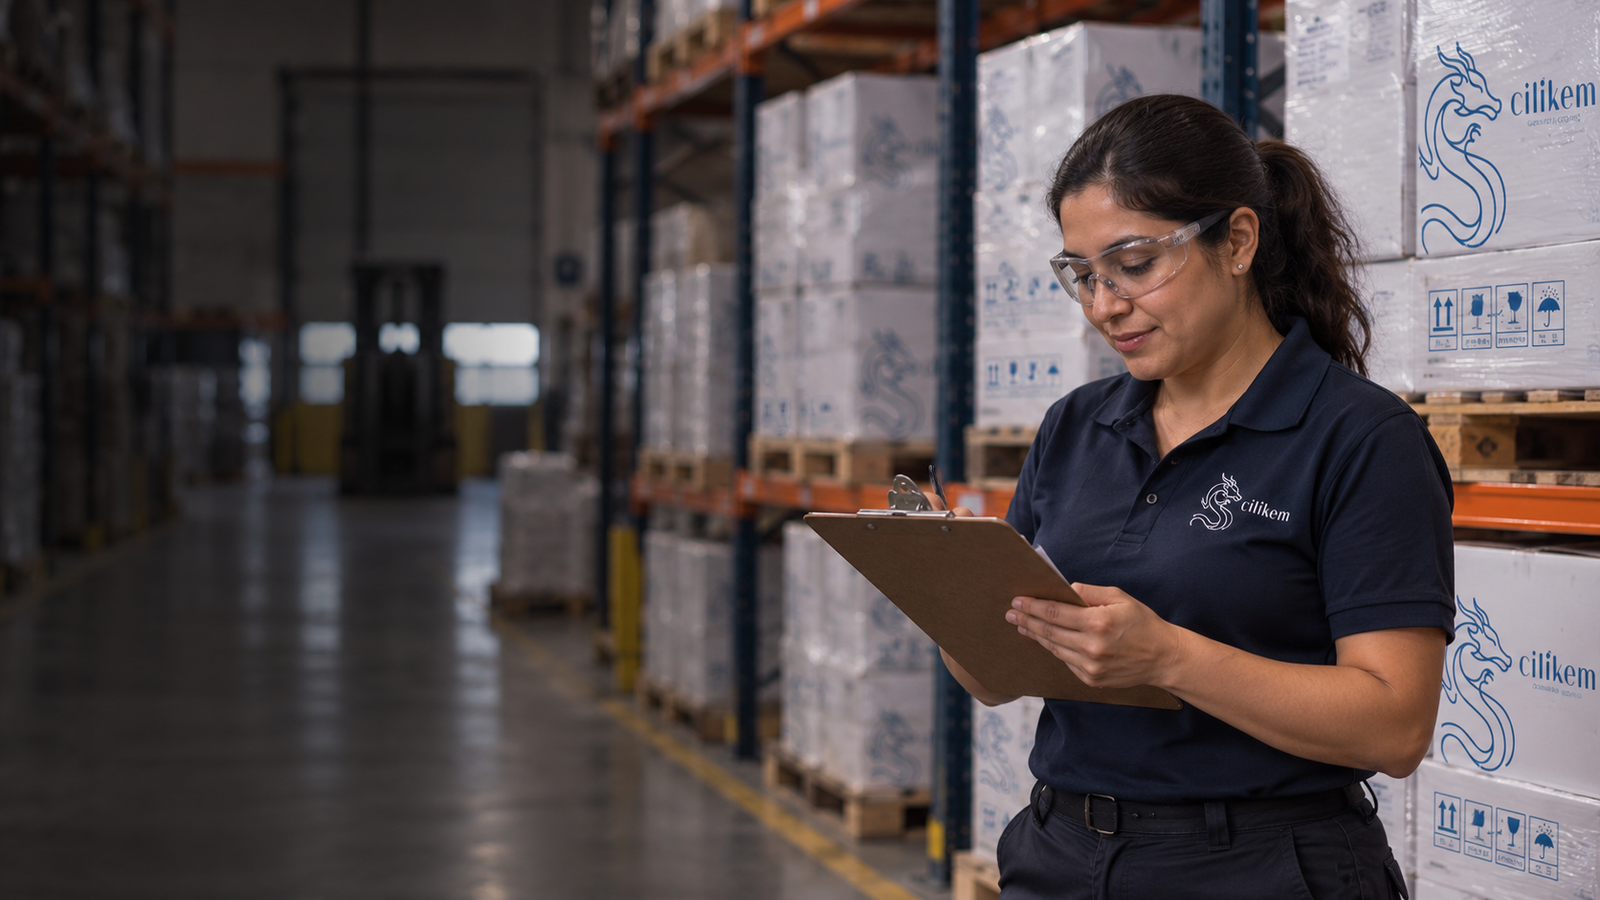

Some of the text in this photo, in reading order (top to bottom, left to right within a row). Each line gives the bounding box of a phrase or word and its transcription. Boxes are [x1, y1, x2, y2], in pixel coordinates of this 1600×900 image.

[1510, 78, 1596, 116] cilikem
[1241, 499, 1290, 522] cilikem
[1519, 650, 1596, 691] cilikem
